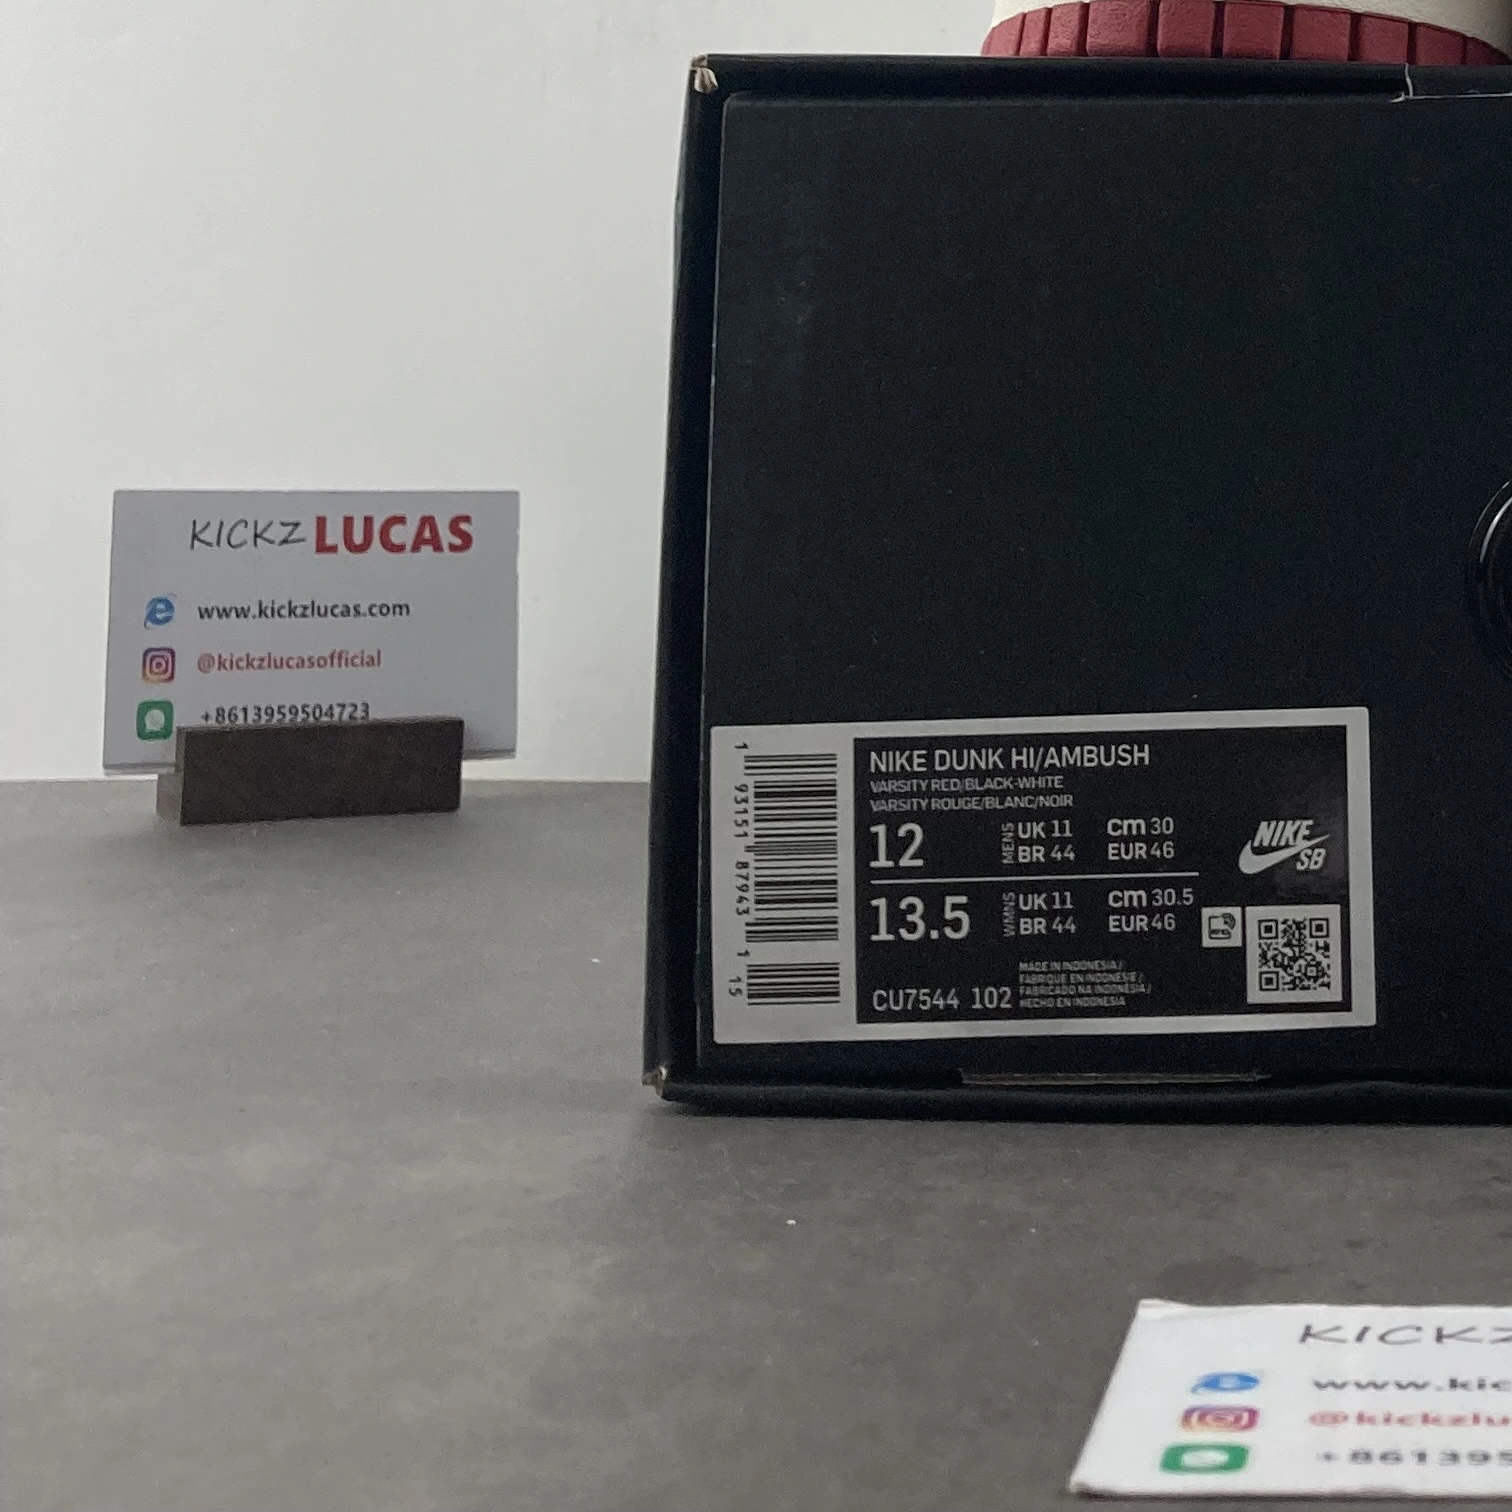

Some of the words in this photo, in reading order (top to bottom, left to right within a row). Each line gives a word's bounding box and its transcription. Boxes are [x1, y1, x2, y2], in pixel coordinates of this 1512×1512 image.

[190, 518, 306, 551] KICKZ
[314, 514, 474, 554] LUCAS
[197, 600, 411, 621] www.kickzlucas.com
[197, 648, 383, 673] @kickzlucasofficial
[201, 702, 370, 724] +8613959504723
[869, 749, 928, 773] NIKE
[934, 748, 1004, 771] DUNK
[1011, 744, 1150, 772] HI/AMBUSH
[869, 778, 929, 793] VARSITY
[869, 798, 929, 813] VARSITY
[1018, 821, 1046, 838] UK
[1051, 820, 1073, 837] 11
[1107, 818, 1146, 836] cm
[1150, 817, 1174, 835] 30
[1253, 820, 1315, 848] NIKE
[869, 822, 924, 868] 12
[1002, 822, 1015, 864] MENS
[1018, 845, 1045, 863] BR
[1051, 844, 1076, 861] 44
[1107, 842, 1147, 861] EUR
[1150, 841, 1175, 859] 46
[1296, 848, 1327, 871] SB
[1019, 894, 1048, 911] UK
[1052, 892, 1074, 909] 11
[1108, 890, 1147, 908] cm
[1152, 888, 1194, 906] 30.5
[869, 895, 970, 941] 13.5
[1020, 918, 1047, 935] BR
[1052, 917, 1077, 933] 44
[1109, 915, 1149, 933] EUR
[1151, 913, 1176, 931] 46
[729, 976, 743, 997] 15
[872, 989, 960, 1011] CU7544
[971, 988, 1012, 1009] 102
